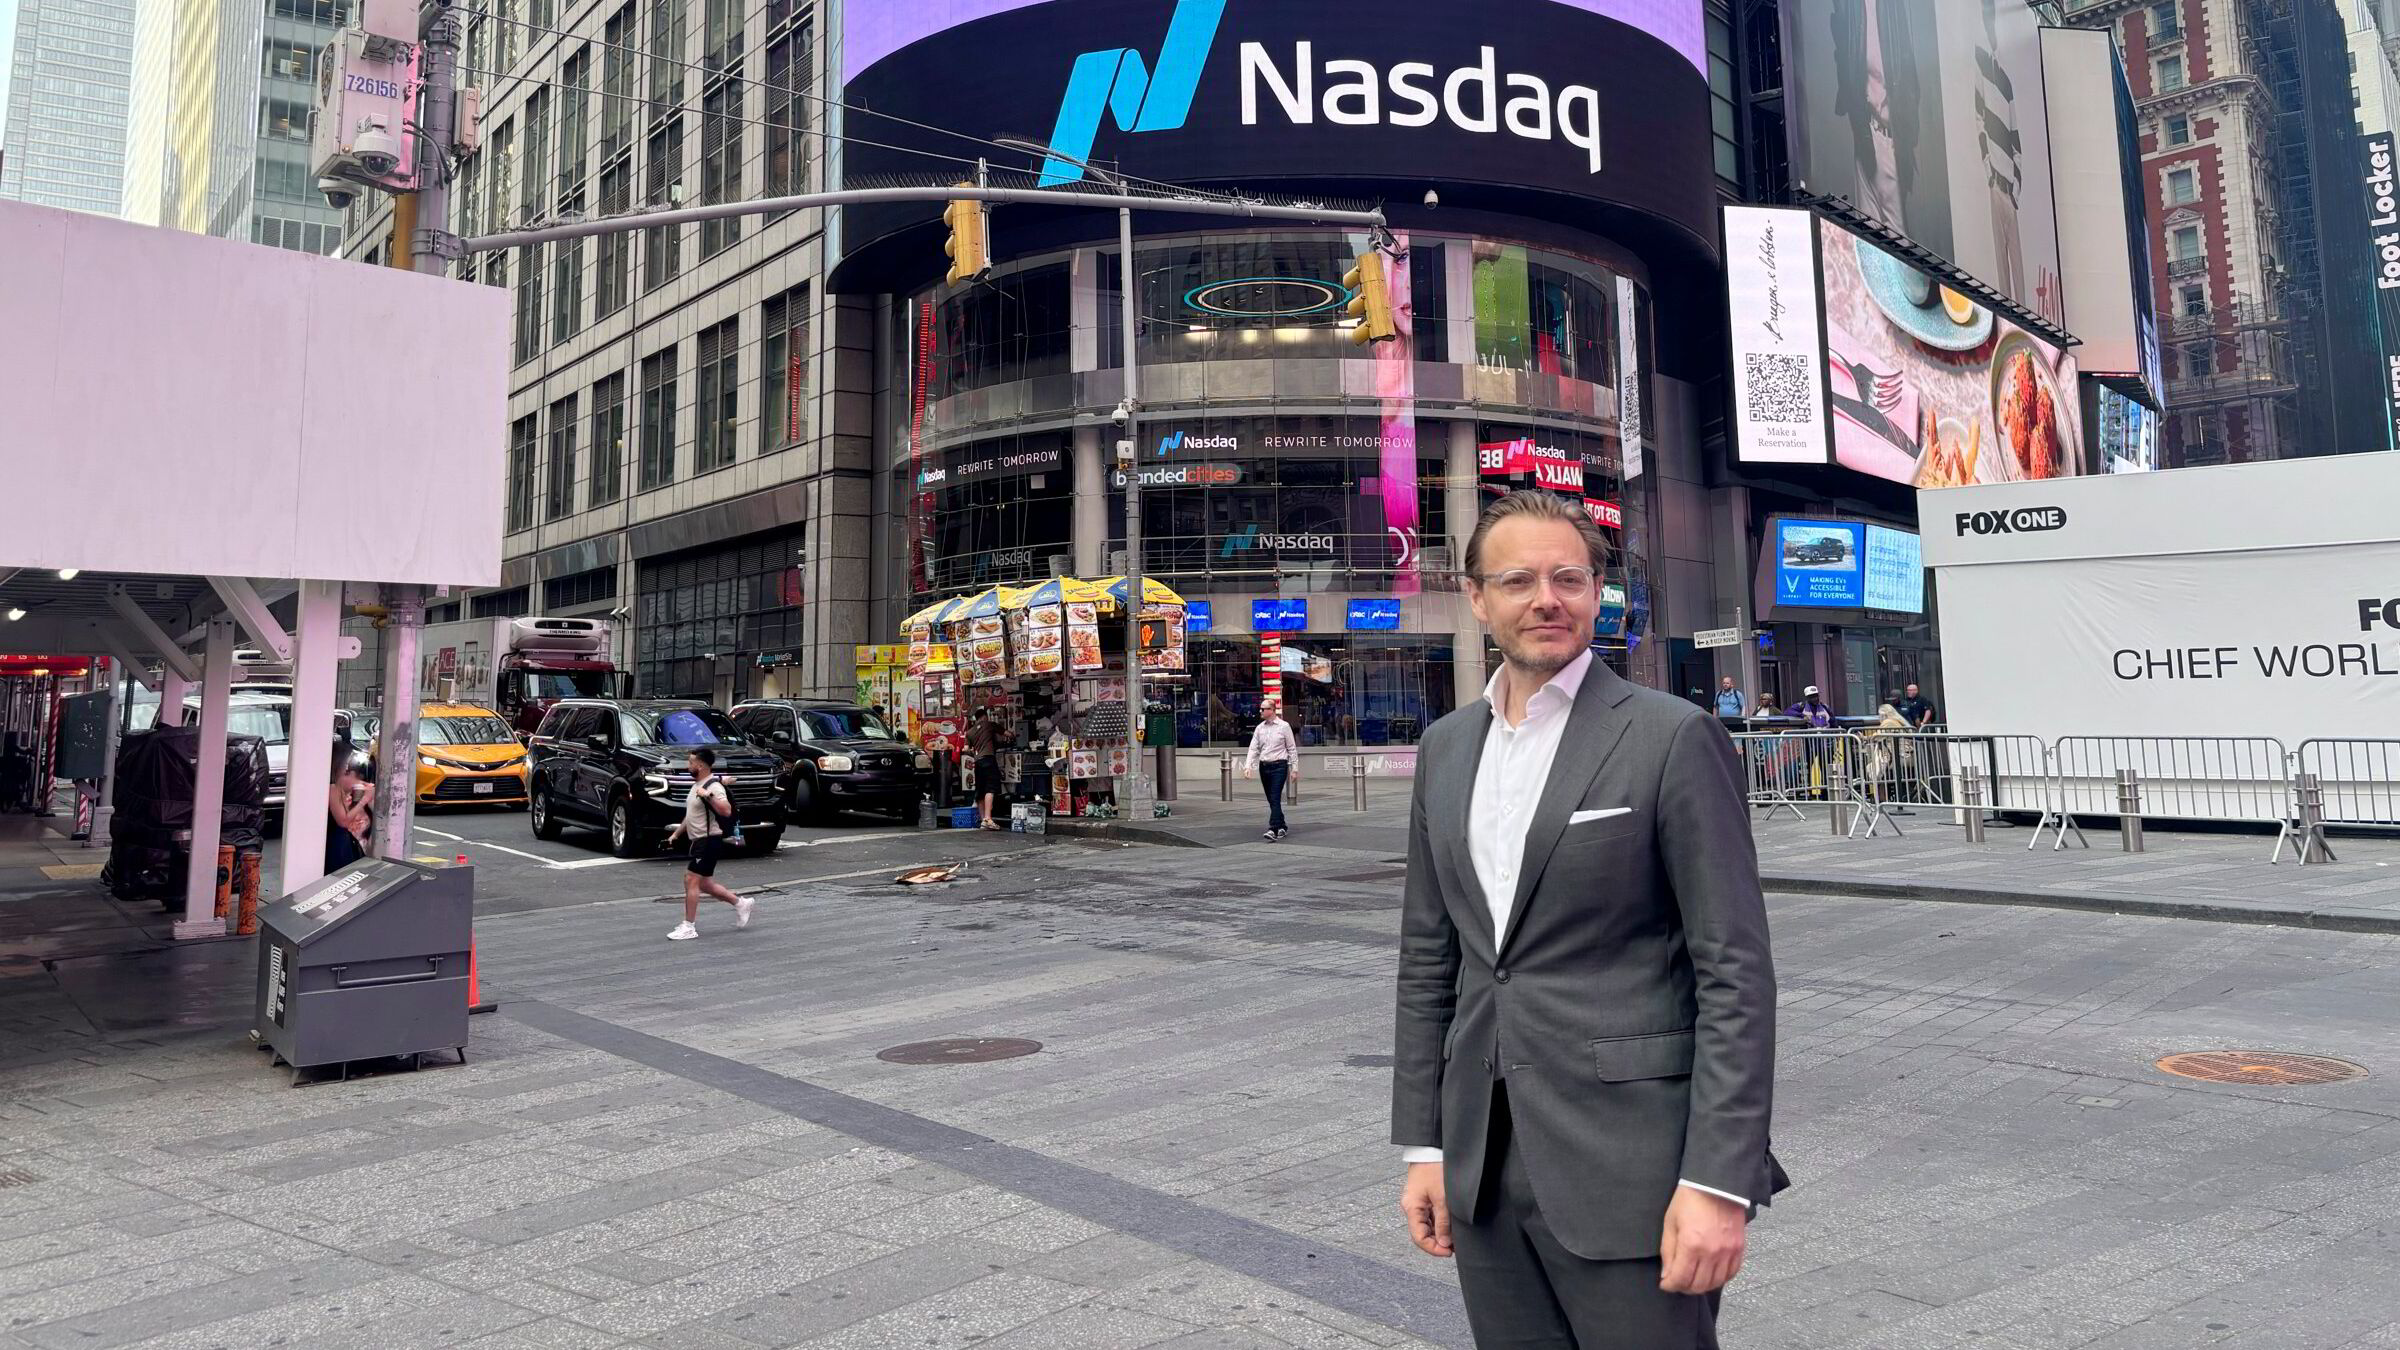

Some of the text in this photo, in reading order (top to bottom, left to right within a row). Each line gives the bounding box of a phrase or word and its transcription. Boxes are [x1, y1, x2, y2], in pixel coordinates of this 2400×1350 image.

[1240, 41, 1601, 174] Nasdaq
[2374, 232, 2400, 289] Foot
[1766, 427, 1790, 436] Make
[1184, 435, 1237, 450] Nasdaq
[1264, 436, 1413, 448] REWRITE TOMORROW
[1758, 437, 1807, 448] Reservation
[1528, 444, 1566, 462] Nasdaq
[1581, 452, 1612, 468] REWRITE
[924, 450, 1059, 483] Nasdaq REWRITE TOMORROW
[1956, 510, 2060, 537] FOX ONE
[1259, 532, 1334, 553] Nasdaq
[991, 549, 1031, 567] Nasdaq
[1809, 584, 1846, 592] ACCESSIBLE
[1823, 592, 1855, 600] EVERYONE
[2113, 643, 2399, 680] CHIEF WORL
[1384, 757, 1417, 769] Nasda
